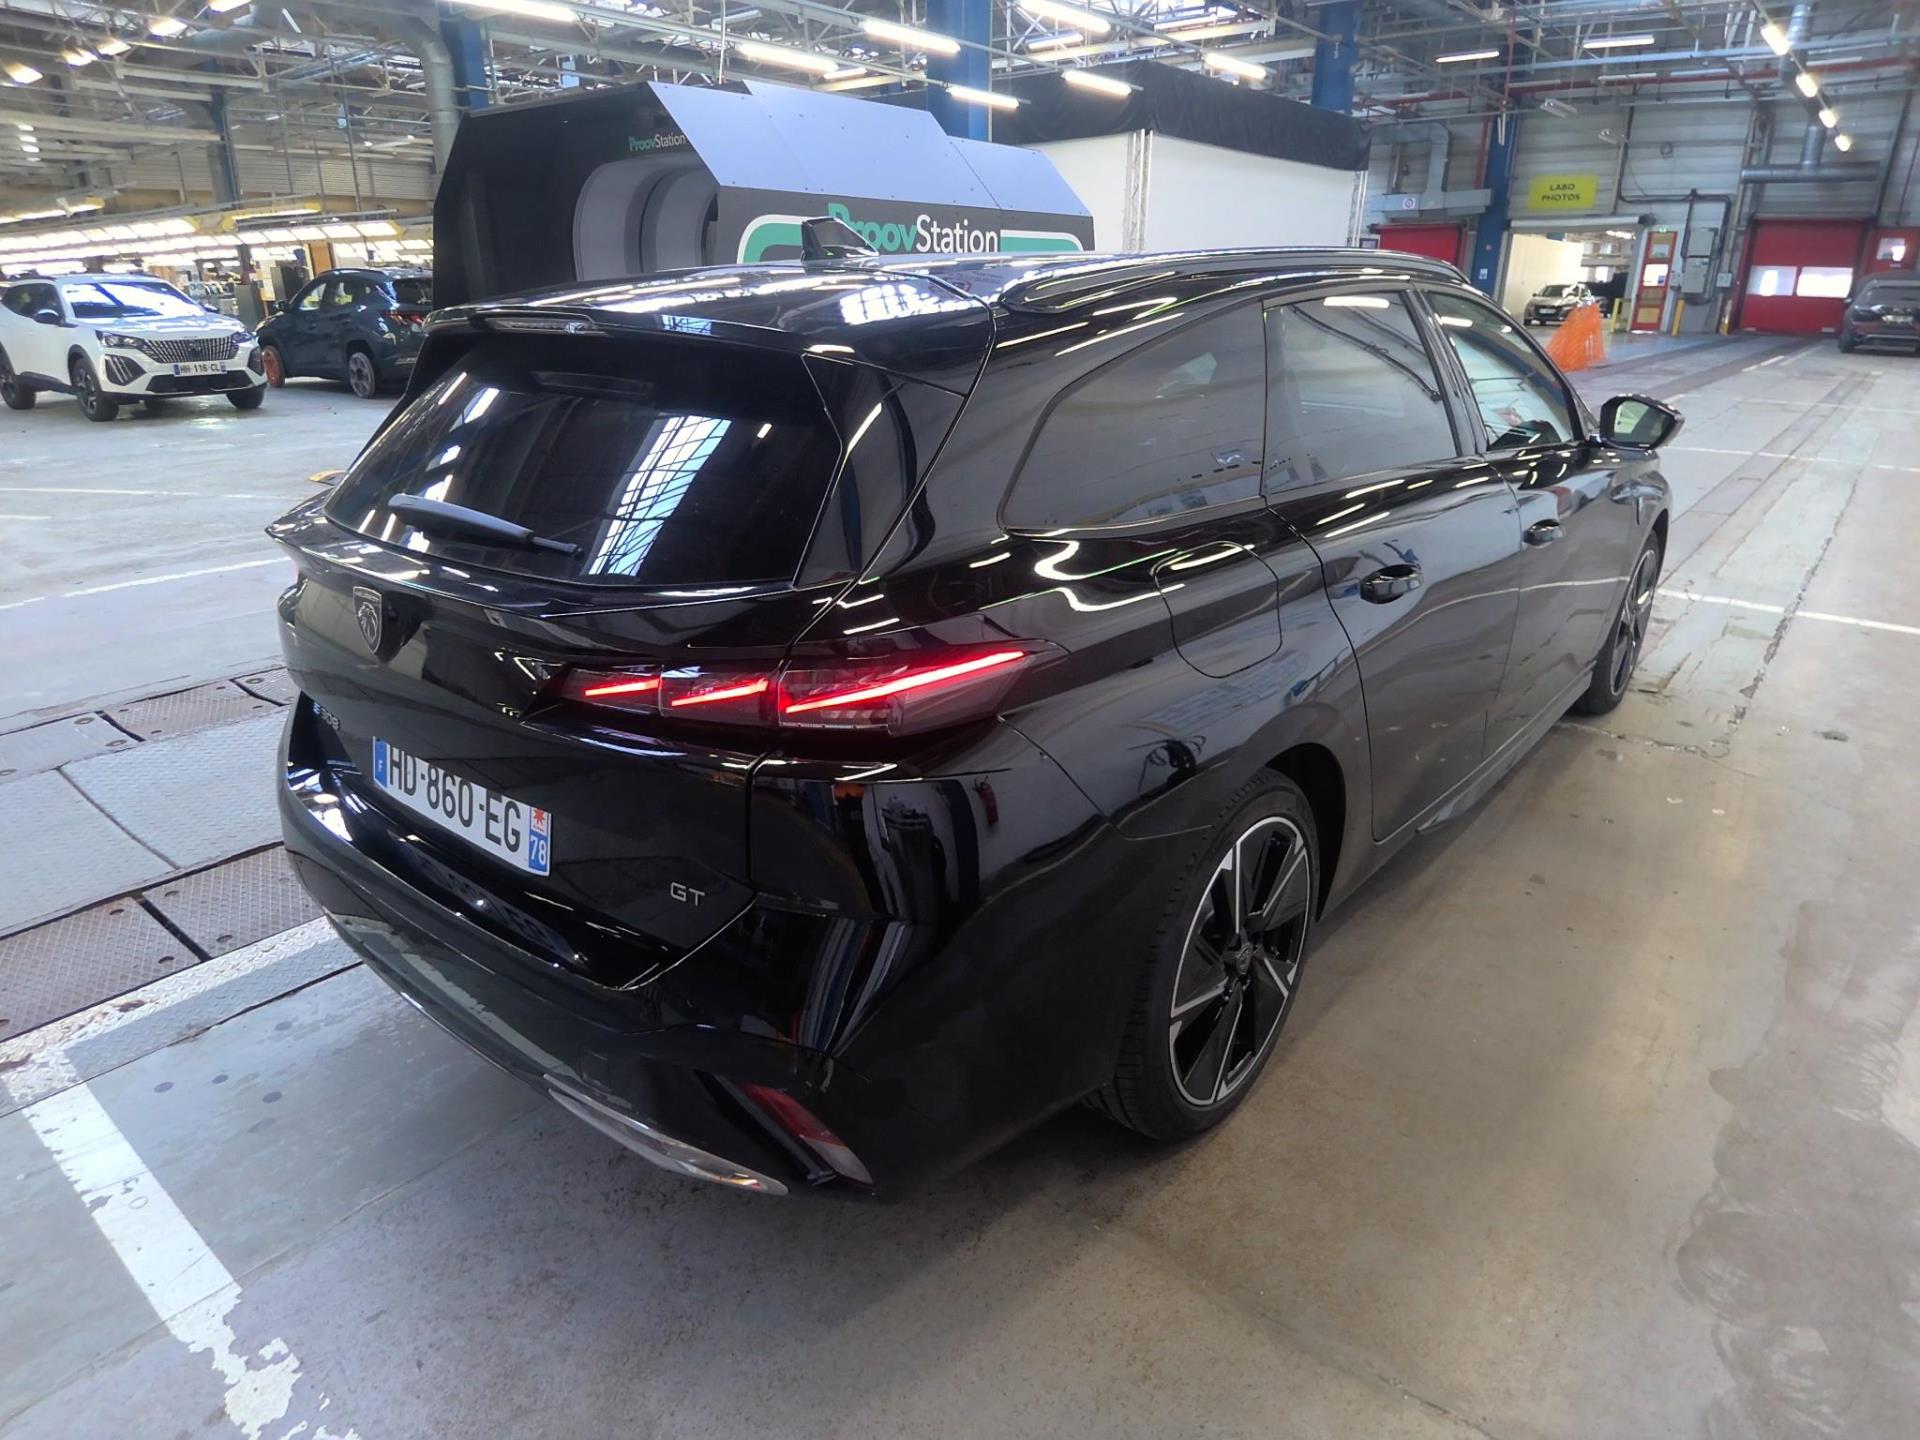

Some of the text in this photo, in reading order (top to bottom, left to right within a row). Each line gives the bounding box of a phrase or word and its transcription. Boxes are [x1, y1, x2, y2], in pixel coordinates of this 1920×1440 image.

[628, 132, 686, 152] ProovStation
[1549, 183, 1576, 191] LABO
[1541, 193, 1581, 202] PHOTOS
[530, 834, 547, 865] 78
[670, 882, 705, 906] GT
